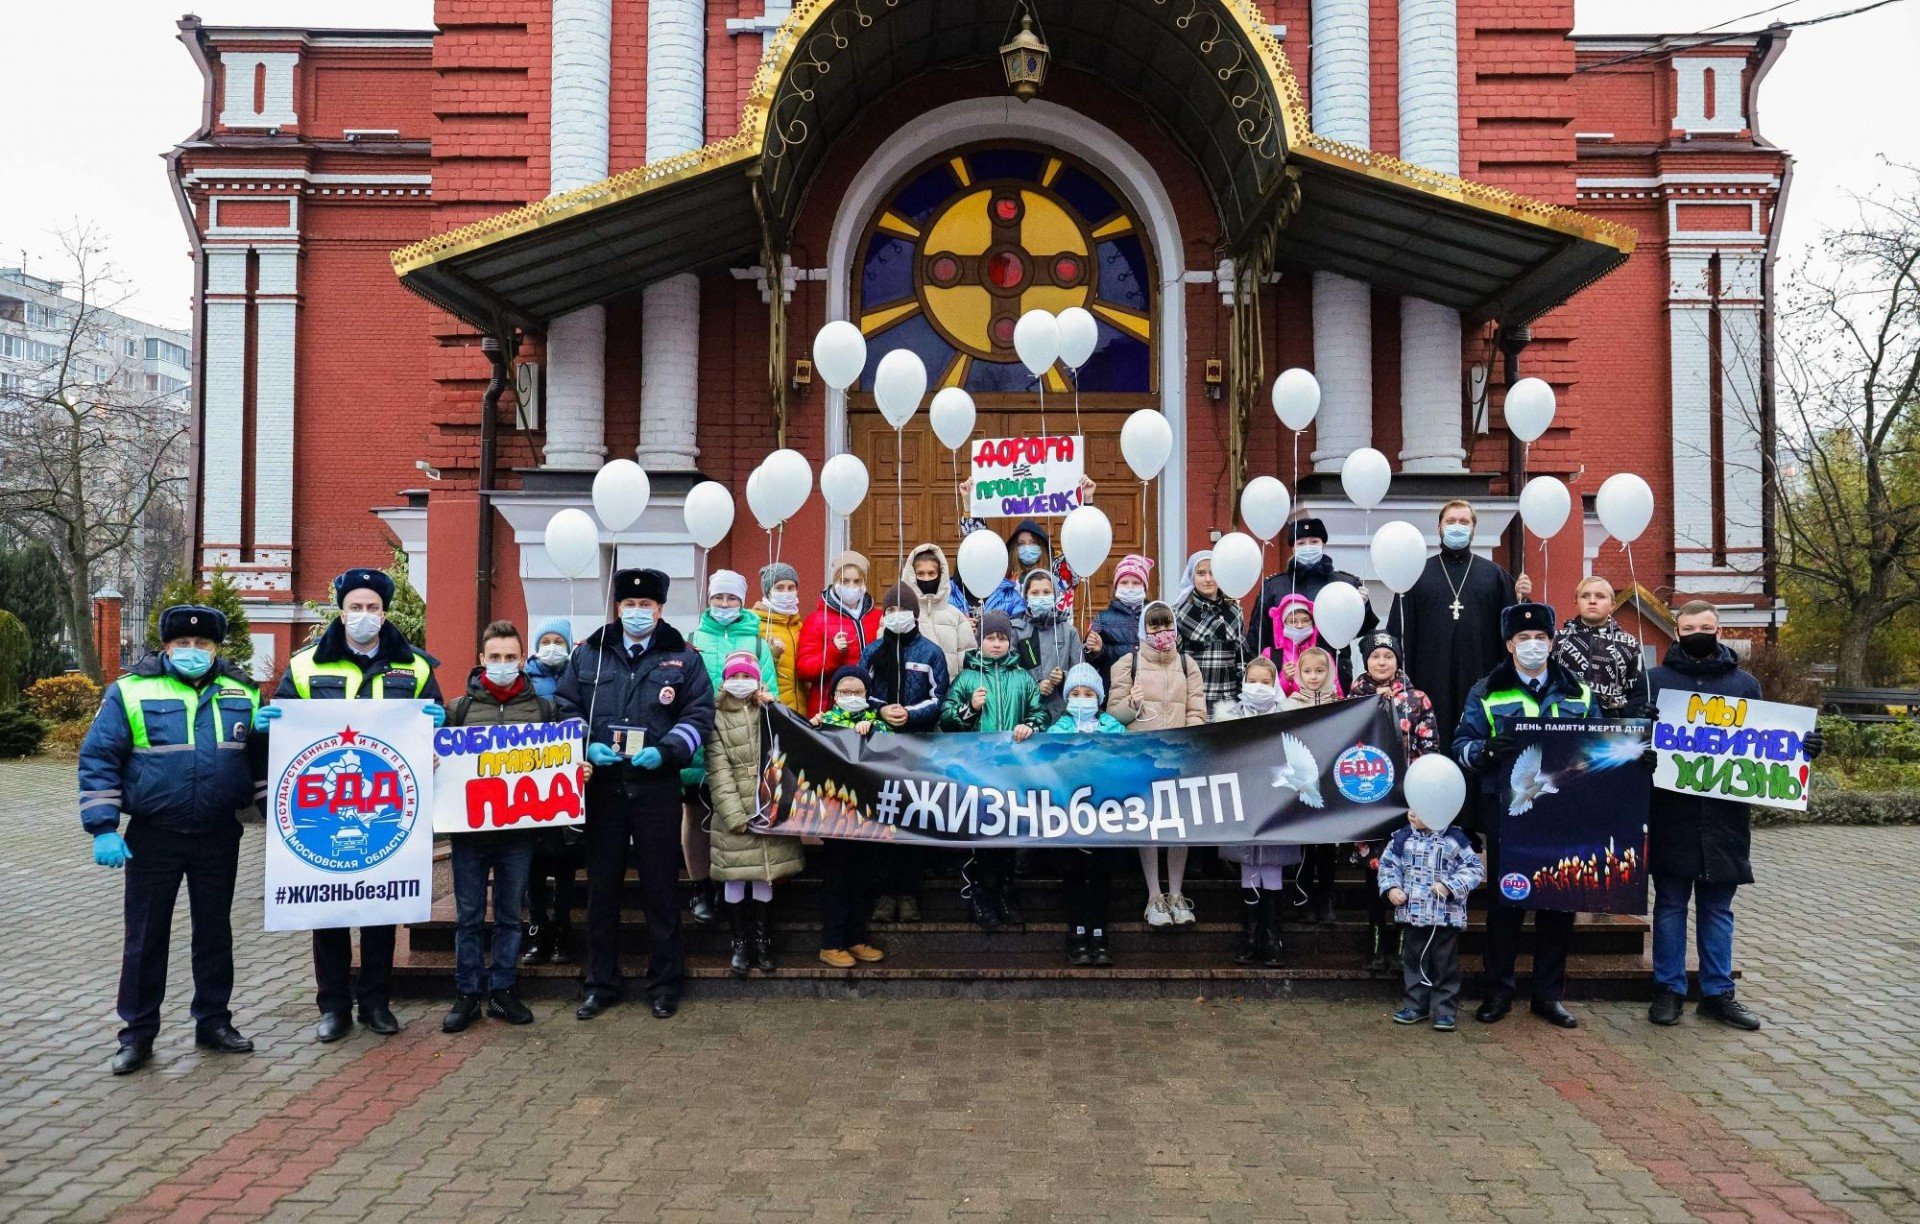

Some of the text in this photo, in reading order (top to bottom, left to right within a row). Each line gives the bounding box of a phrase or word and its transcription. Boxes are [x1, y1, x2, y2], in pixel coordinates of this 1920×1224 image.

[973, 436, 1074, 467] ДОРОГА
[976, 477, 1047, 500] ПРОЩАЕТ
[1515, 723, 1645, 734] ДЕНЬ ПАМЯТИ ЖЕРТВ ДТП
[1687, 693, 1748, 727] МЫ
[477, 742, 573, 777] ПРАВИЛА
[1654, 722, 1812, 762] ВЫБИРАЕМ
[279, 738, 416, 831] ГОСУДАРСТВЕННАЯ ИНСПЕКЦИЯ
[1340, 758, 1387, 777] БДД
[1672, 753, 1809, 801] ЖИЗНЬ!
[297, 771, 404, 814] БДД
[465, 765, 584, 829] ПДД!
[876, 772, 1244, 841] #ЖИЗНЬбезДТП
[288, 830, 406, 869] МОСКОВСКАЯ ОБЛАСТЬ
[275, 879, 420, 905] #ЖИЗНЬбезДТП
